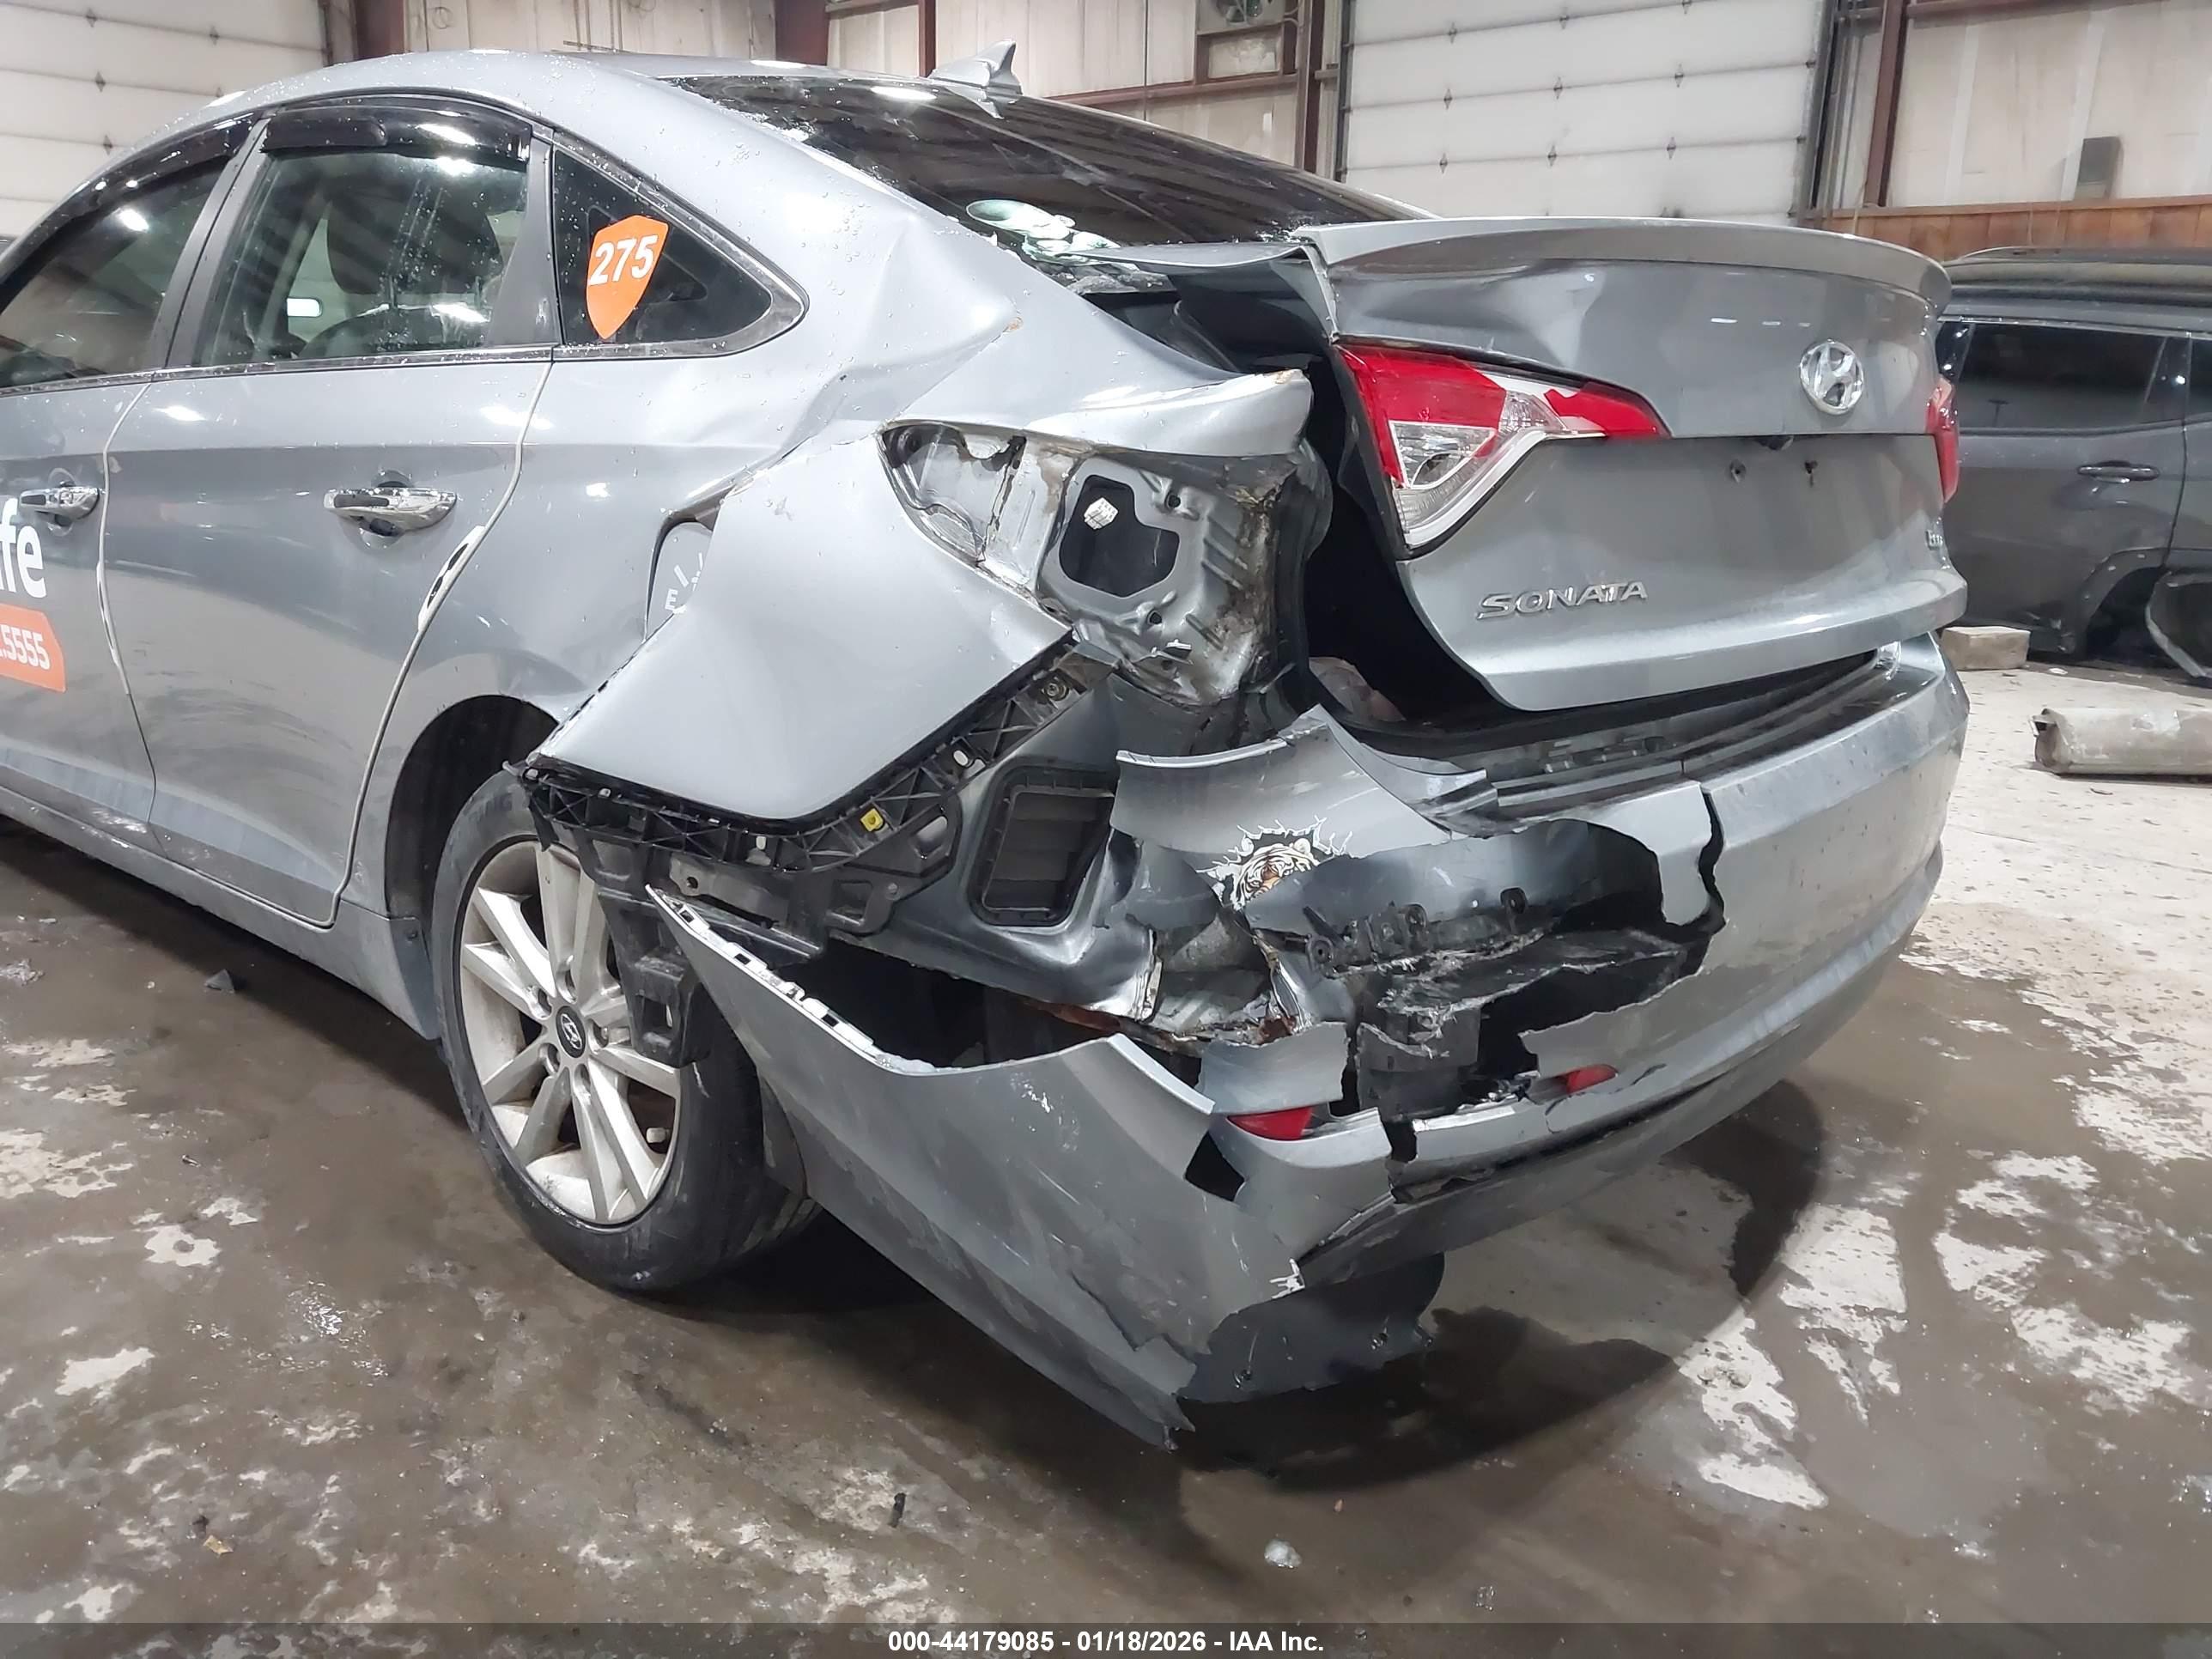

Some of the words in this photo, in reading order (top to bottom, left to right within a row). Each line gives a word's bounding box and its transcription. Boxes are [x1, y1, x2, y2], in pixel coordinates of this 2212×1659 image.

[588, 234, 658, 286] 275
[0, 498, 46, 598] fe
[1476, 581, 1649, 619] SONATA
[0, 623, 51, 670] .5555
